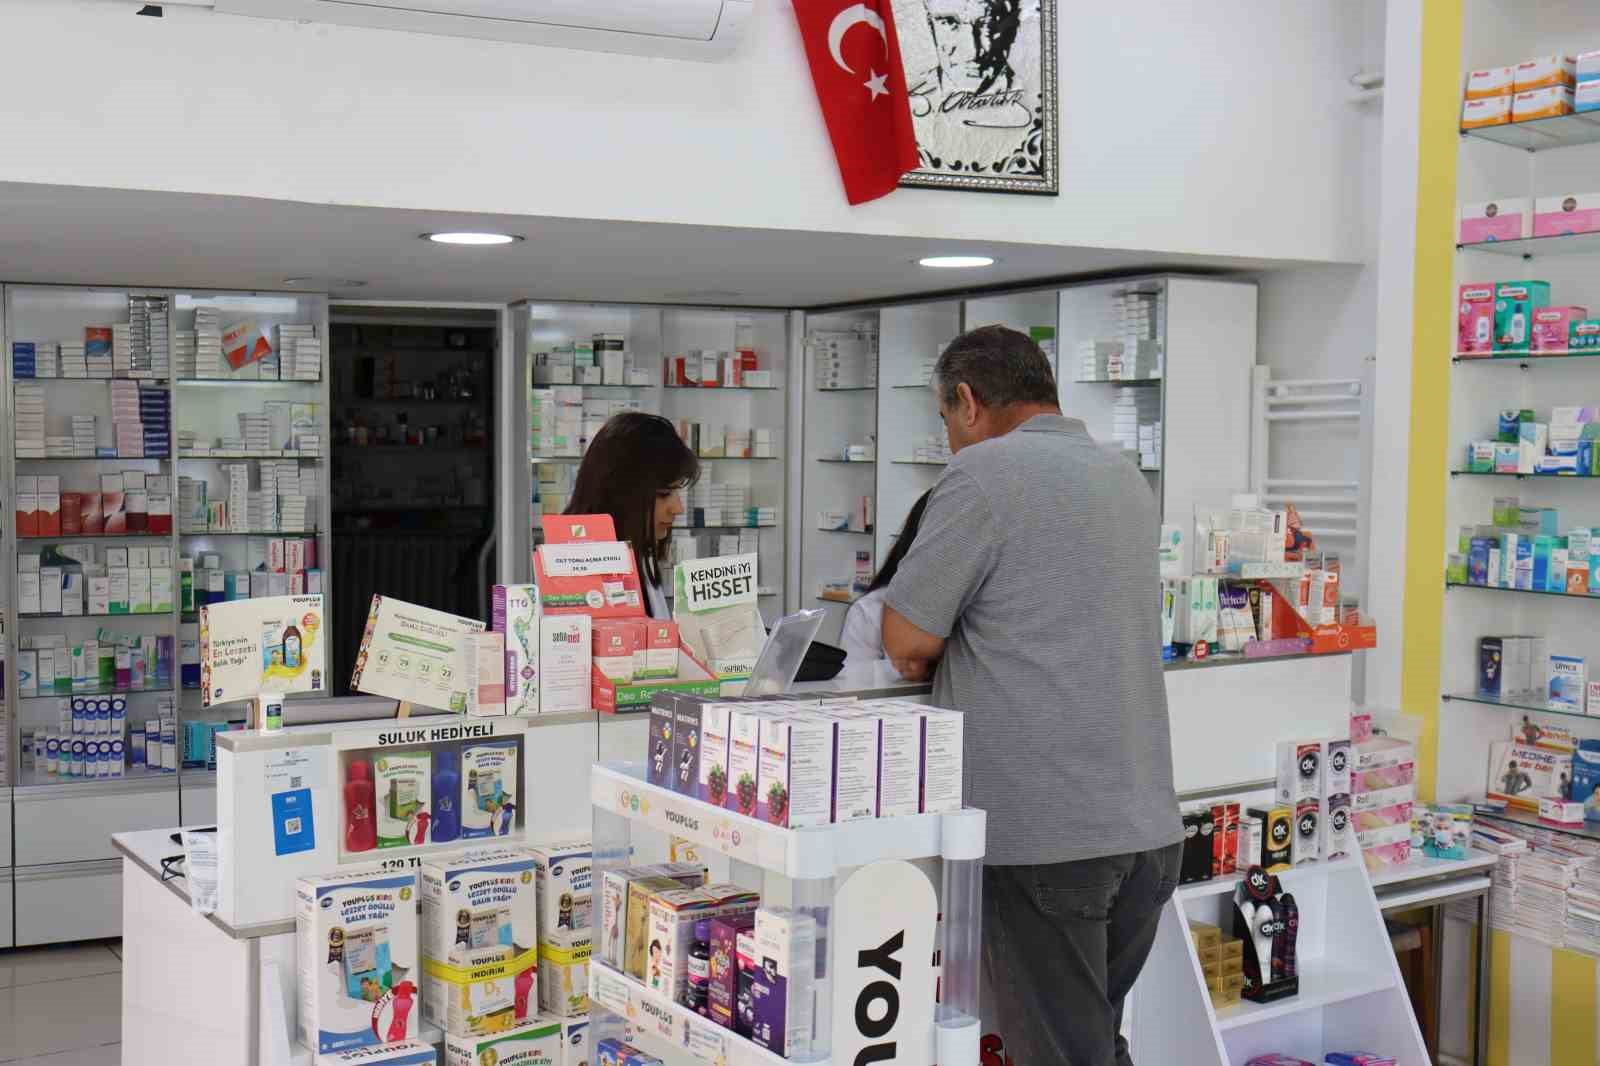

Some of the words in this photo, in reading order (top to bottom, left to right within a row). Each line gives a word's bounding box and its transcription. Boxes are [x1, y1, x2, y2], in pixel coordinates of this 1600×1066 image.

[378, 729, 427, 745] SULUK
[430, 721, 494, 741] HEDİYELİ
[664, 808, 699, 830] YOUPLUS
[471, 954, 506, 967] YOUPLUS
